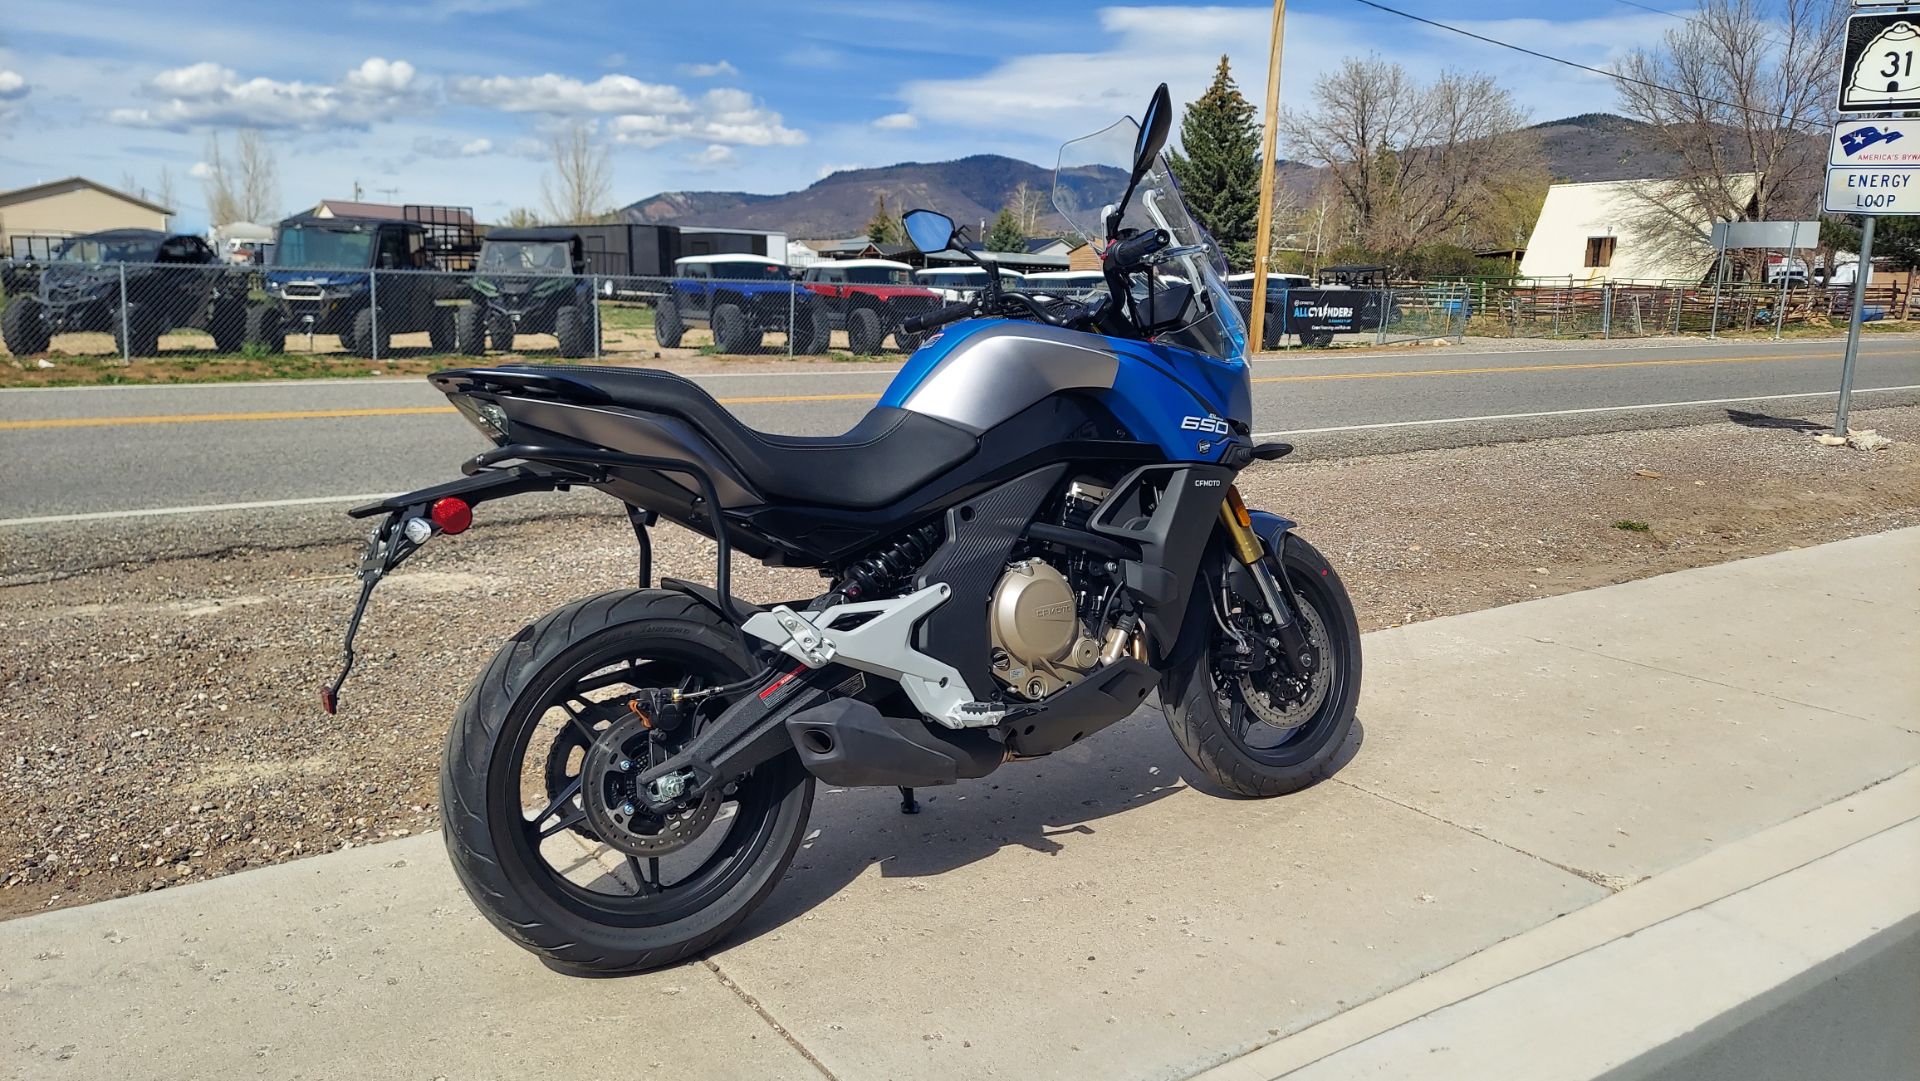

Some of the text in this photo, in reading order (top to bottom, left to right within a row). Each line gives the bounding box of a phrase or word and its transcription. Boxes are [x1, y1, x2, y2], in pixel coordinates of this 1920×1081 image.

[1880, 51, 1913, 77] 31
[1857, 153, 1899, 161] AMERICA'S
[1848, 175, 1911, 187] ENERGY
[1856, 195, 1896, 207] LOOP
[1181, 416, 1228, 434] 650
[1037, 605, 1071, 617] CFMOTO
